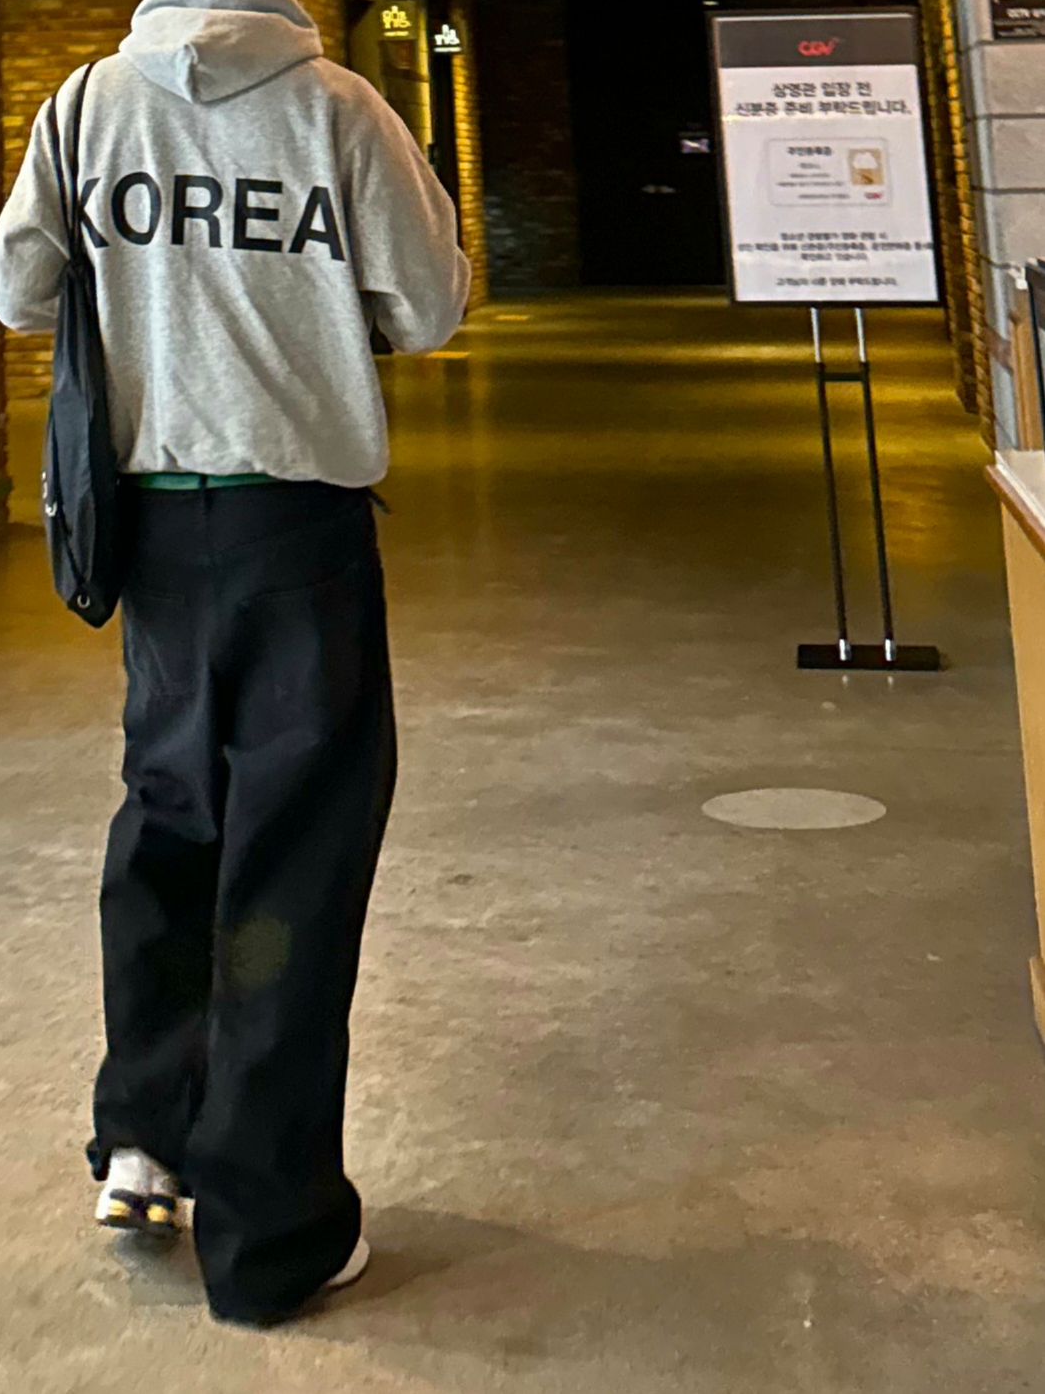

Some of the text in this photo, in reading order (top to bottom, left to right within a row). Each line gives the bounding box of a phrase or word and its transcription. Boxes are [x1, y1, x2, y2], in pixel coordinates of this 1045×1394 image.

[797, 40, 836, 56] CGV
[772, 81, 873, 98] 상영관 입장 전
[735, 99, 912, 117] 신분증 준비 부탁드립니다.
[78, 171, 346, 262] KOREA
